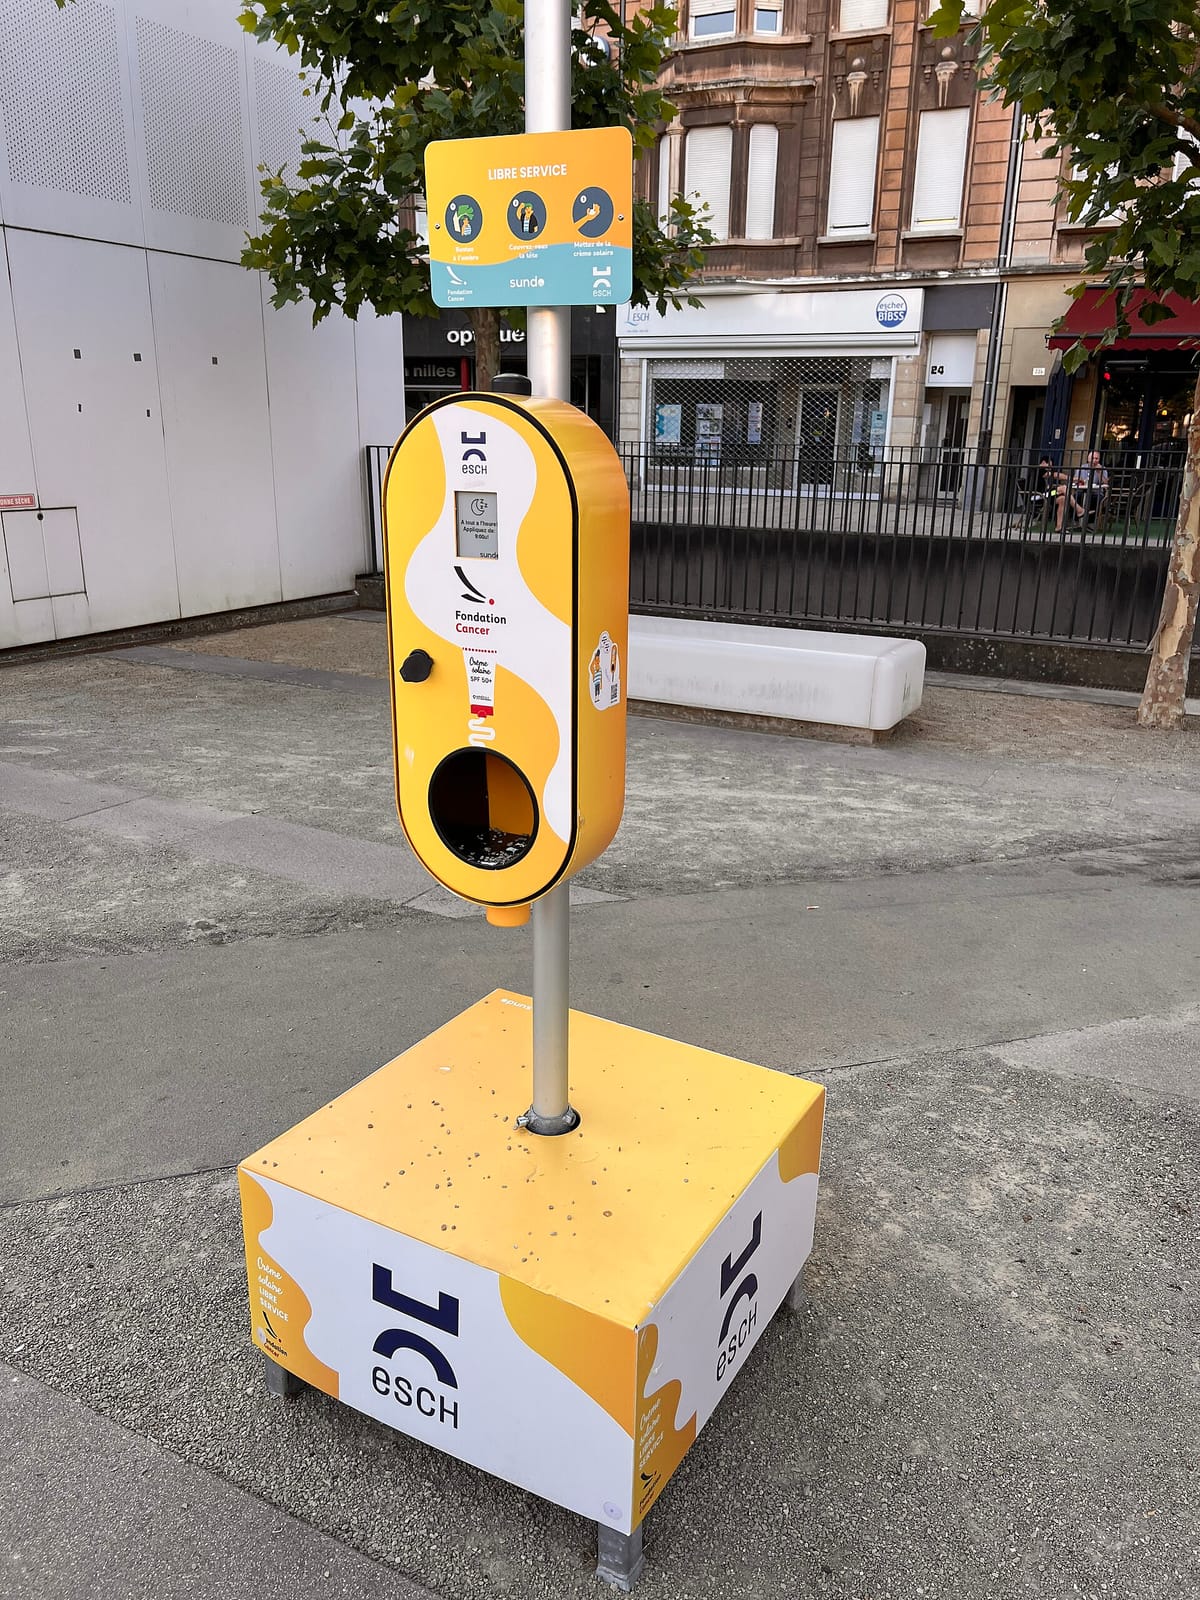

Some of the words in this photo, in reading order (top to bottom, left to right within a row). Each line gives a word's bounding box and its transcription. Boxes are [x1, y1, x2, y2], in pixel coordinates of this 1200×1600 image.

[488, 167, 517, 180] LIBRE
[520, 164, 567, 178] SERVICE
[446, 329, 525, 346] opue
[413, 364, 456, 377] nilles
[930, 365, 944, 375] 24
[455, 610, 507, 624] Fondation
[455, 623, 490, 636] Cancer
[481, 676, 492, 684] 50+
[259, 1286, 278, 1304] LIBRE
[260, 1298, 288, 1322] SERVICE
